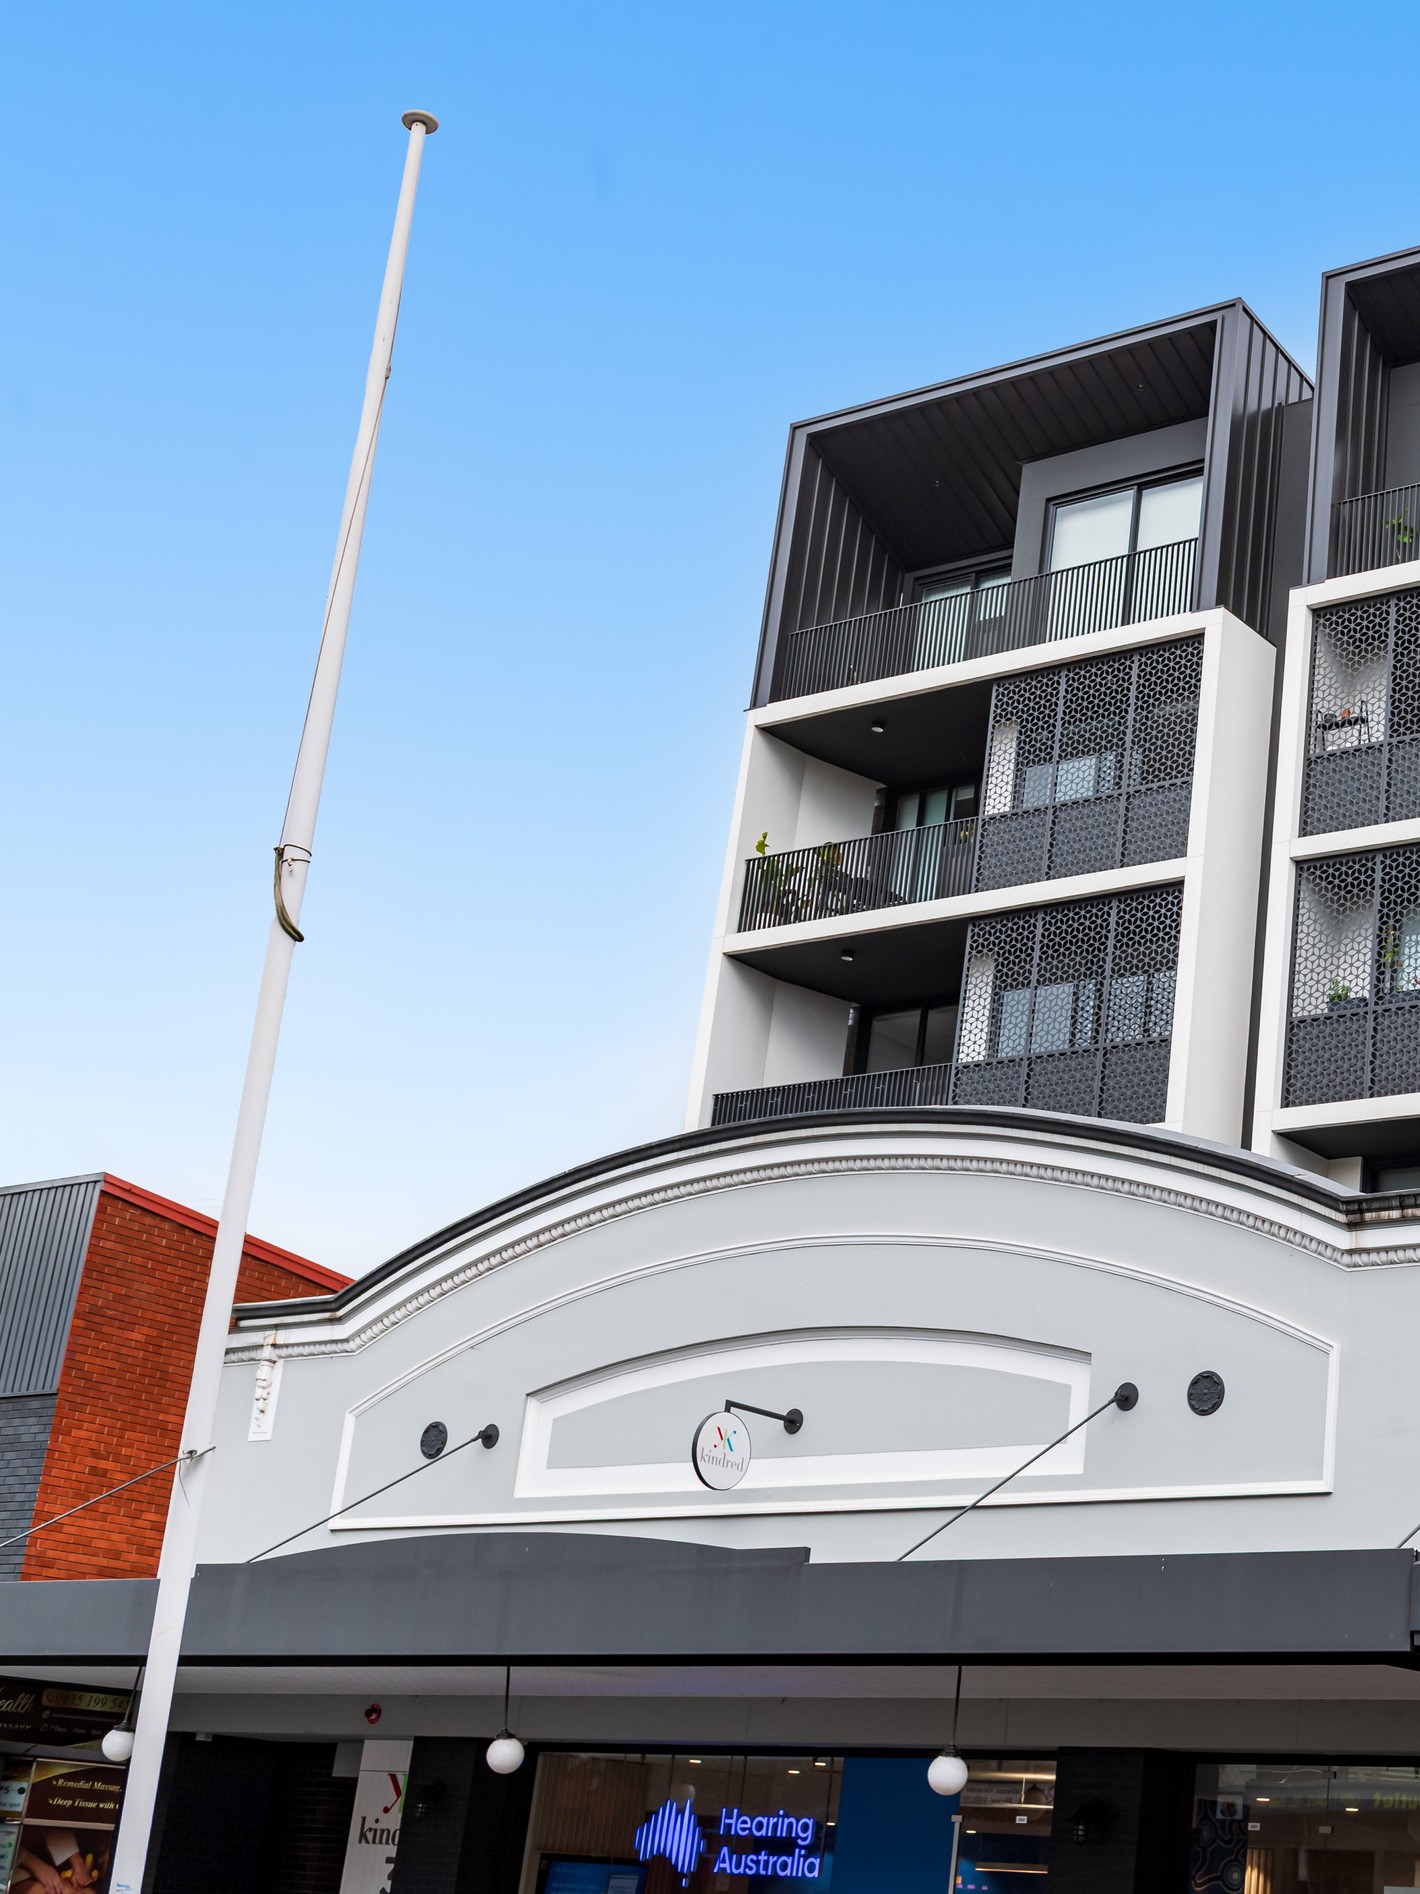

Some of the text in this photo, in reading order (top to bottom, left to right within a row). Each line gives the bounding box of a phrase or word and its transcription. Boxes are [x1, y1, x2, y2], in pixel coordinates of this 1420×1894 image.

[700, 1447, 745, 1472] kindred
[0, 1688, 36, 1713] ealth
[87, 1695, 107, 1708] 199
[57, 1778, 122, 1792] Remedial Massag
[52, 1797, 73, 1808] Deep
[74, 1799, 98, 1808] Tissue
[99, 1801, 115, 1809] with
[720, 1808, 814, 1845] Hearing
[713, 1846, 820, 1878] Australia
